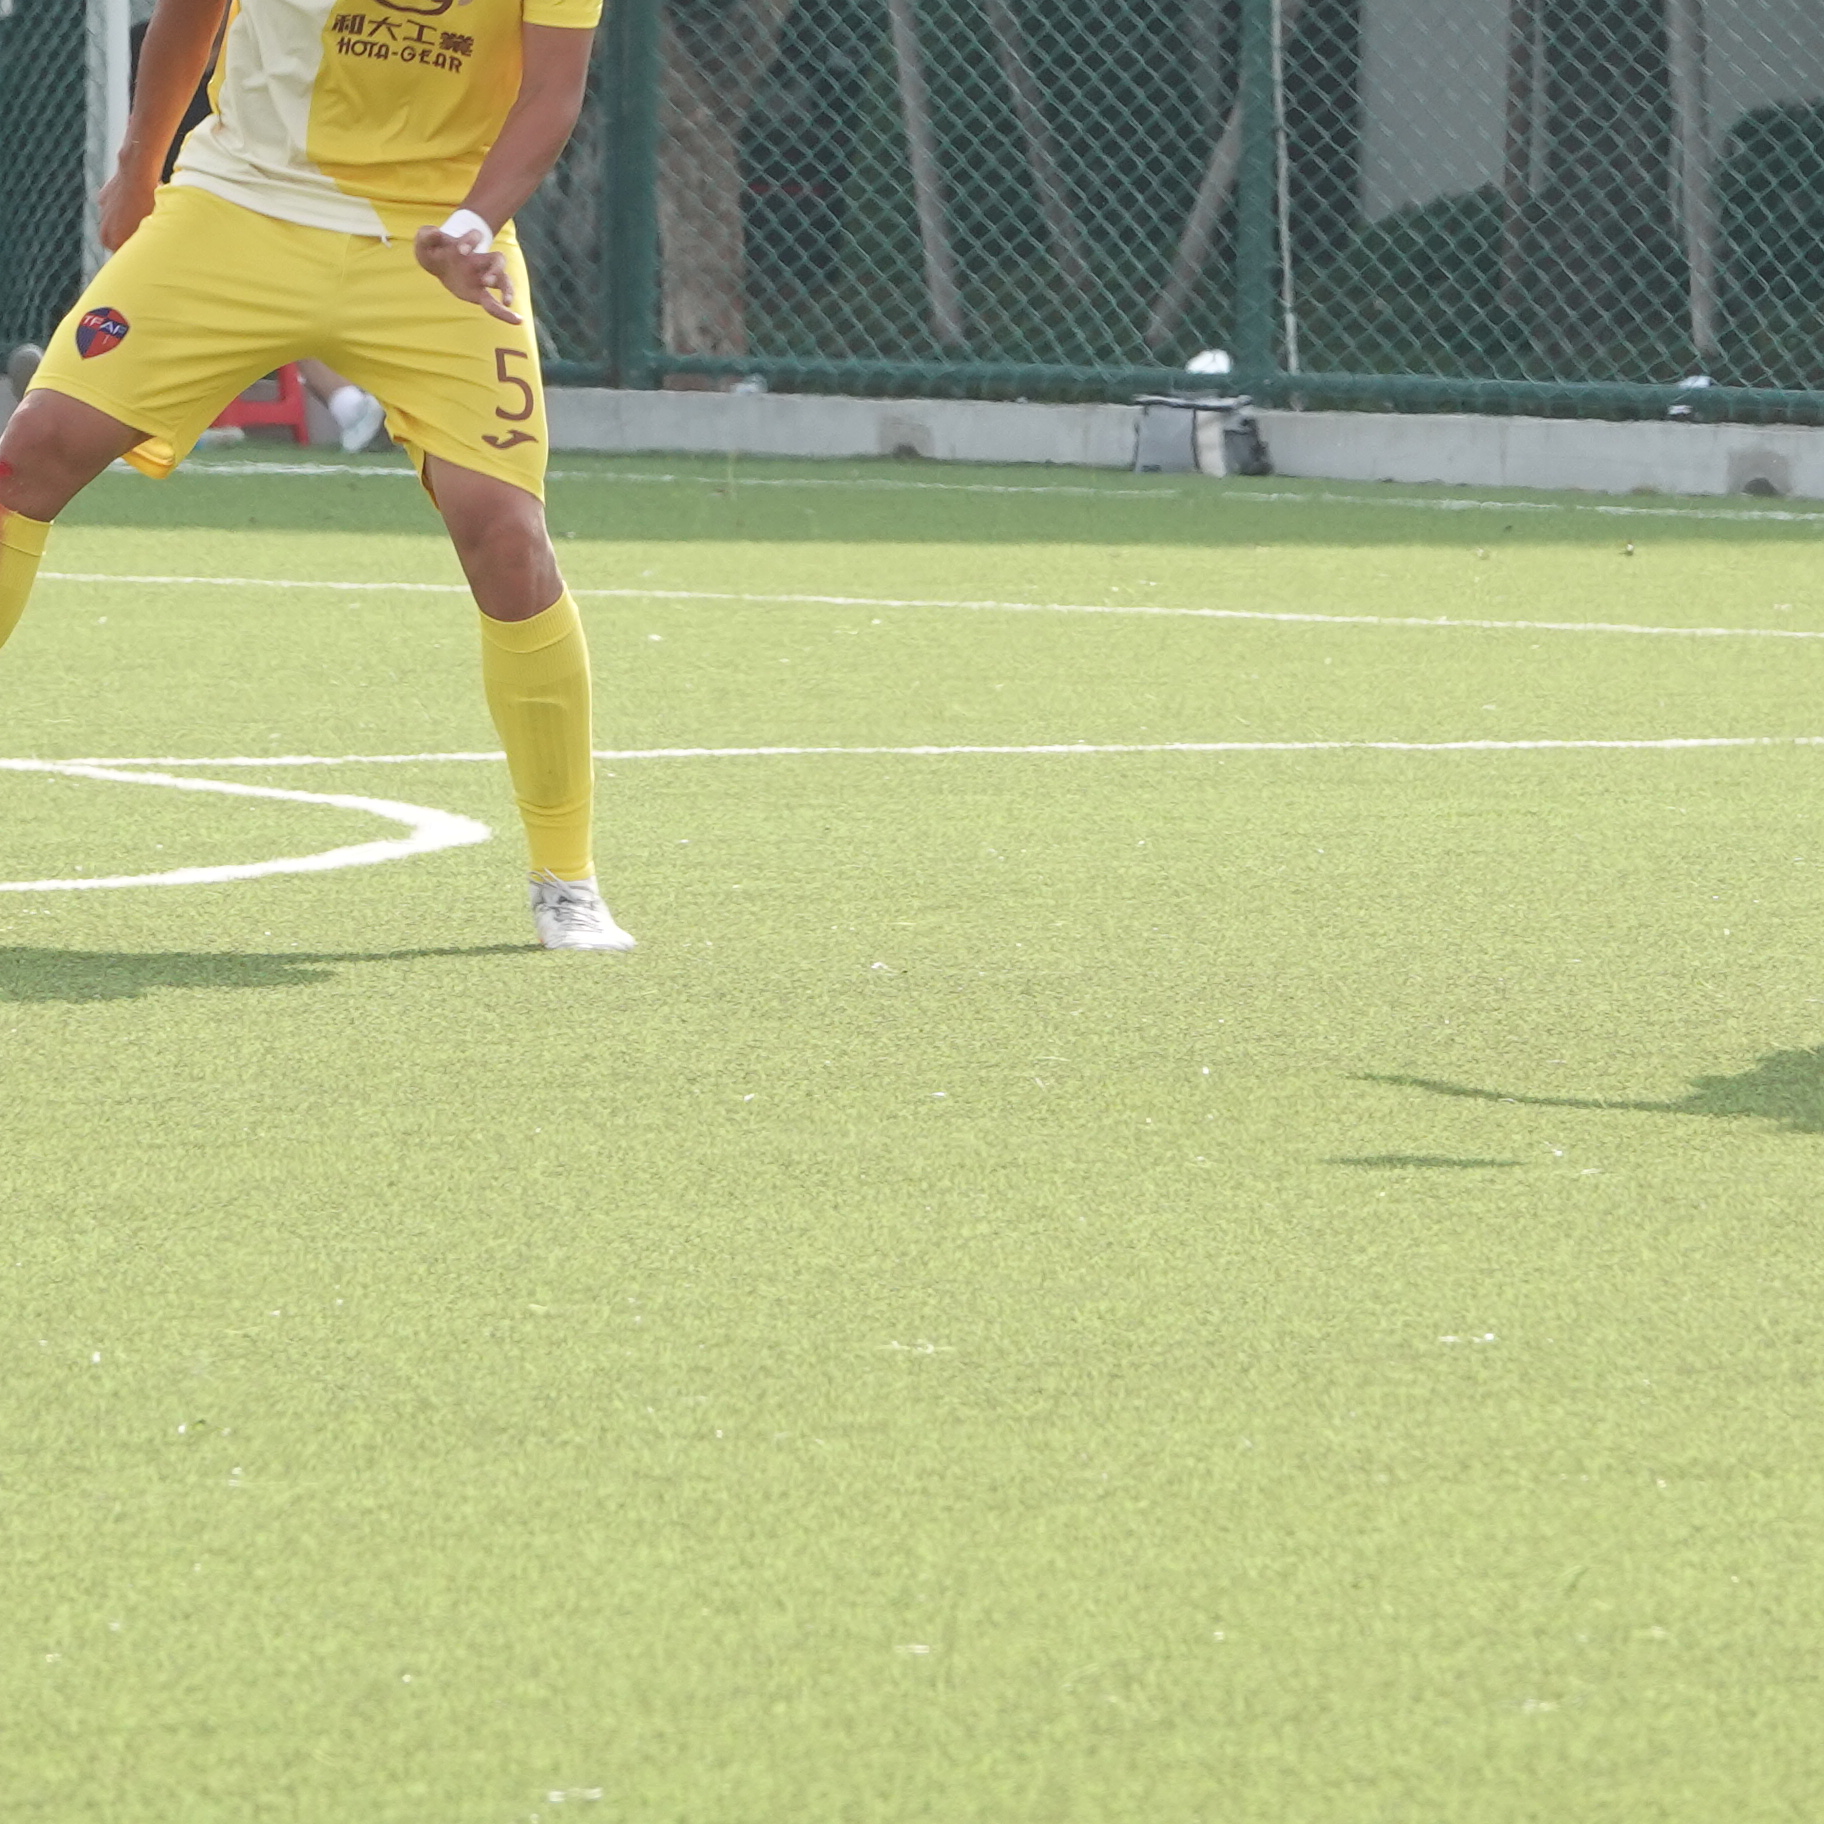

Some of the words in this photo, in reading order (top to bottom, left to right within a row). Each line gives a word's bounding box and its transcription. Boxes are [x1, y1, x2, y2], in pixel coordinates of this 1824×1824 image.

[331, 13, 475, 58] 和大工業
[336, 36, 463, 74] HOTA-GEAR
[495, 347, 534, 421] 5
